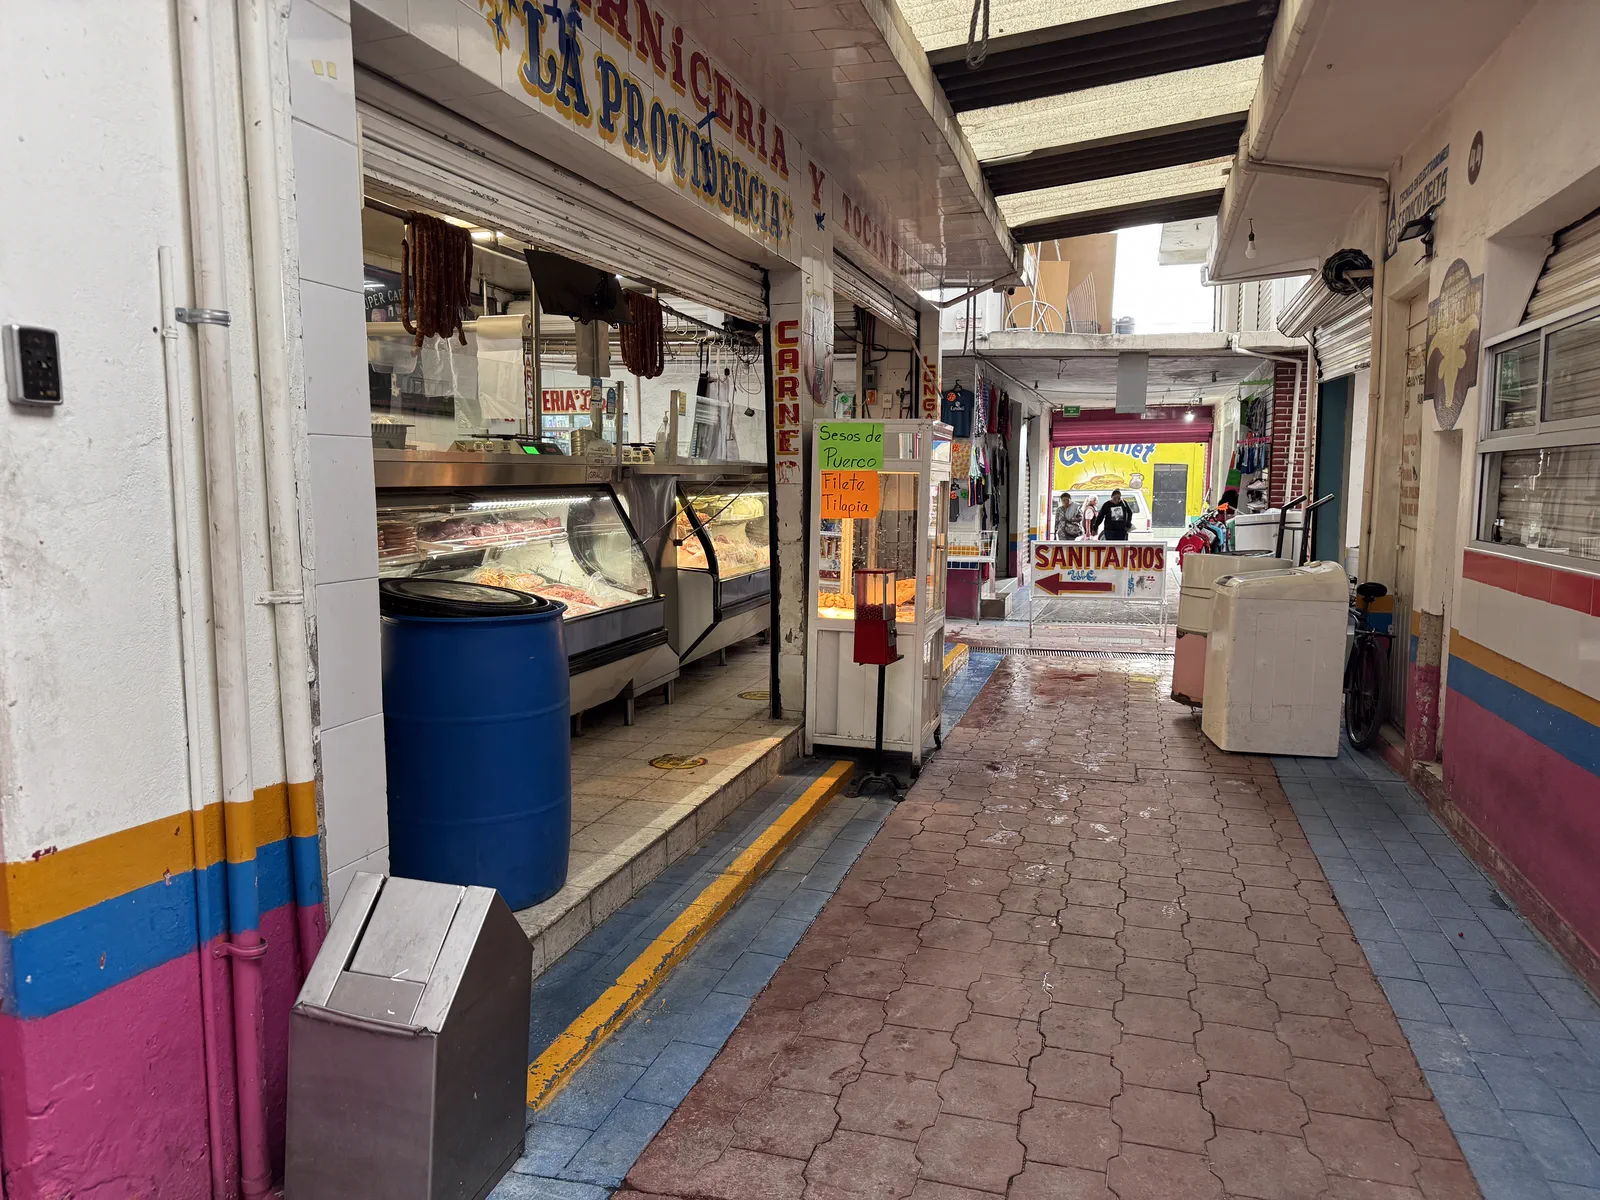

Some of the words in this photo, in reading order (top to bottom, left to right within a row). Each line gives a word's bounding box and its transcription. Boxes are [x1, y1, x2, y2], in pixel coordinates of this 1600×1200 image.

[521, 0, 592, 122] LA
[595, 54, 784, 243] PROVIDENCIA
[807, 160, 826, 209] Y
[820, 425, 861, 441] Sesos
[865, 424, 882, 443] de
[823, 446, 877, 468] Puerco
[821, 472, 866, 491] Filete
[822, 493, 870, 518] Tilapia
[1034, 545, 1165, 571] SANITARIOS
